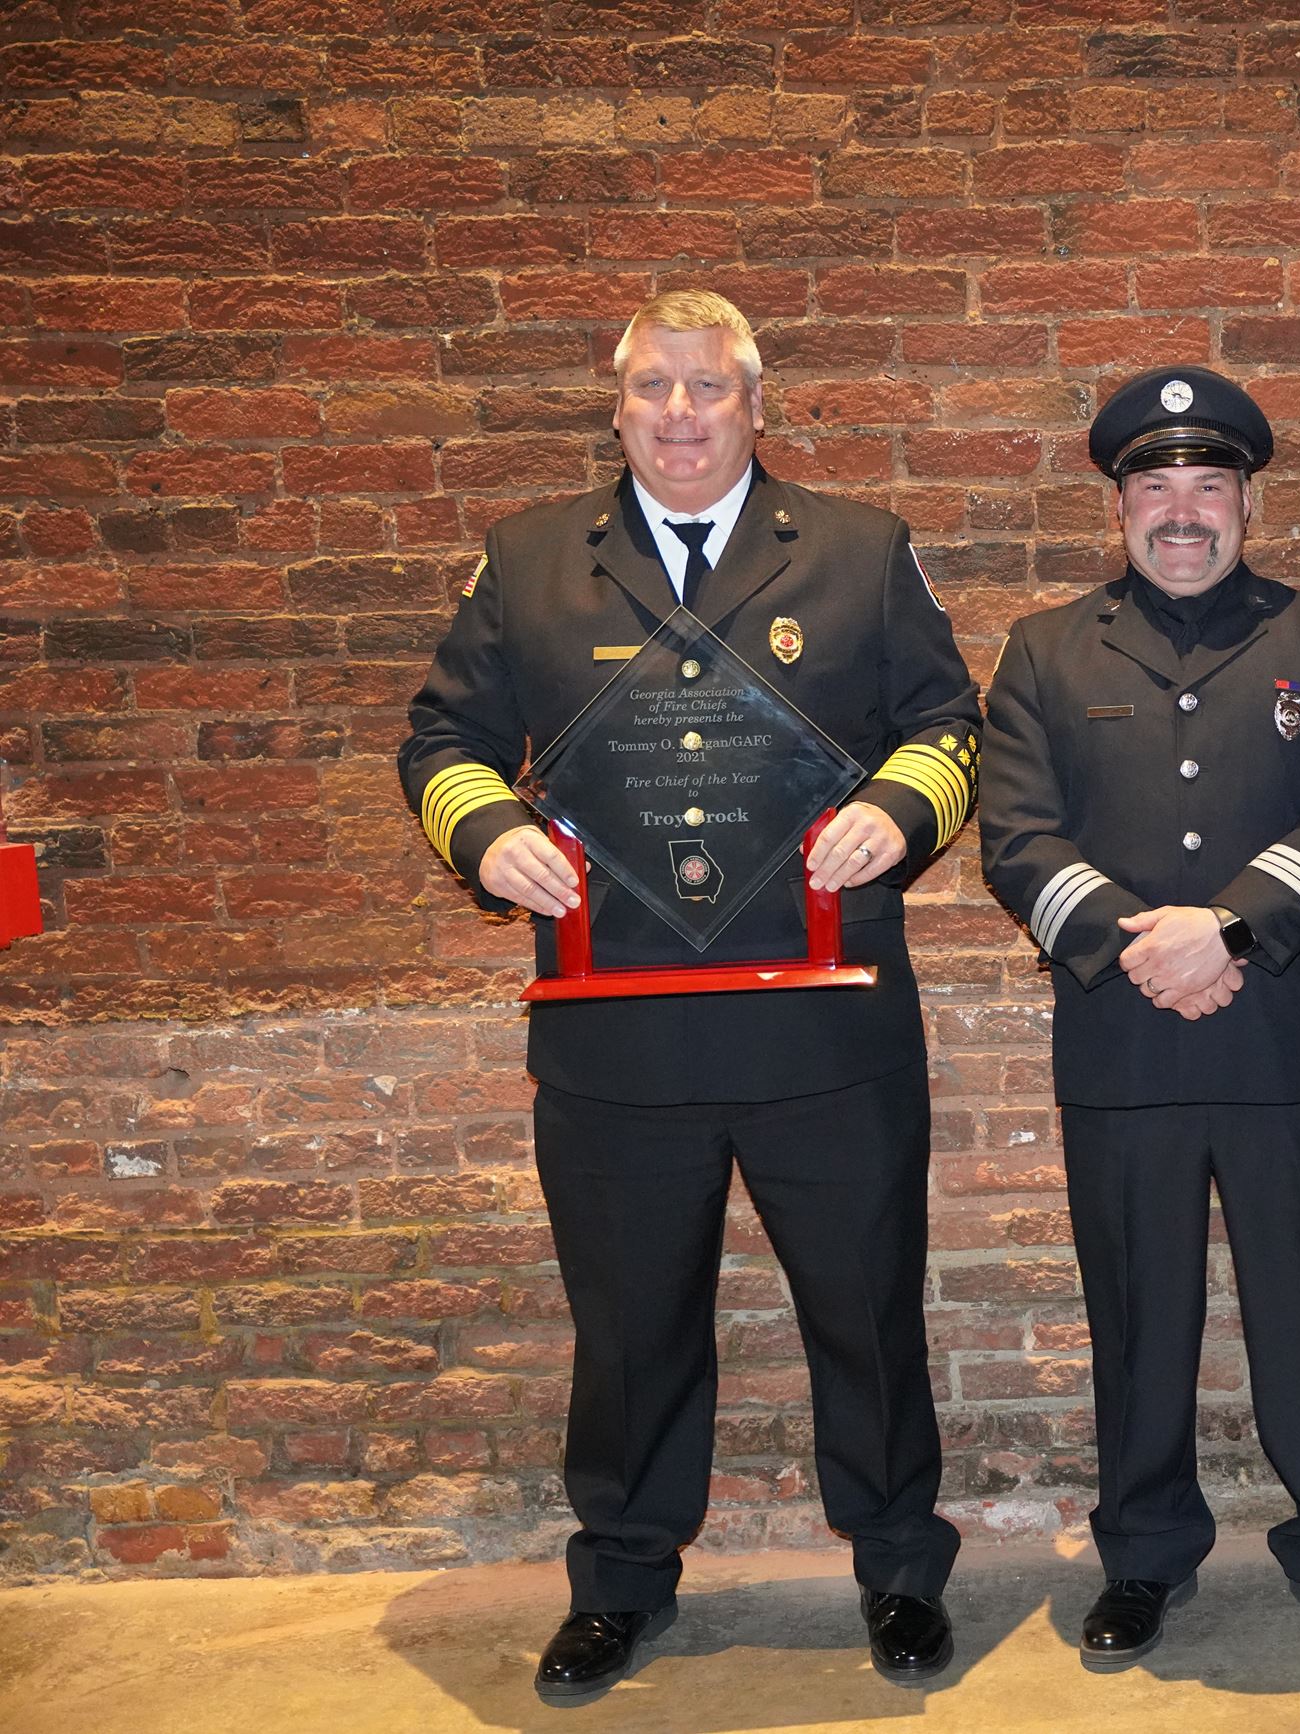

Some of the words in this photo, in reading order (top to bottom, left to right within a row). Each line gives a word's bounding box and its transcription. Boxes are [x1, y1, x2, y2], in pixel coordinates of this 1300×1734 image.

[630, 689, 675, 701] Georgia
[678, 687, 745, 699] Association
[649, 702, 661, 714] of
[664, 702, 688, 711] Fire
[691, 699, 728, 711] Chiefs
[634, 715, 672, 727] hereby
[674, 713, 723, 726] presents
[726, 712, 744, 722] the
[608, 740, 657, 752] Tommy
[661, 739, 676, 750] O.
[680, 735, 772, 751] rgan/GAFC
[676, 752, 707, 763] 2021
[624, 777, 651, 788] Fire
[655, 775, 690, 788] Chief
[692, 774, 706, 788] of
[708, 773, 727, 785] the
[732, 772, 761, 784] Year
[688, 789, 699, 798] to
[640, 811, 686, 828] Troy
[691, 807, 750, 824] rock
